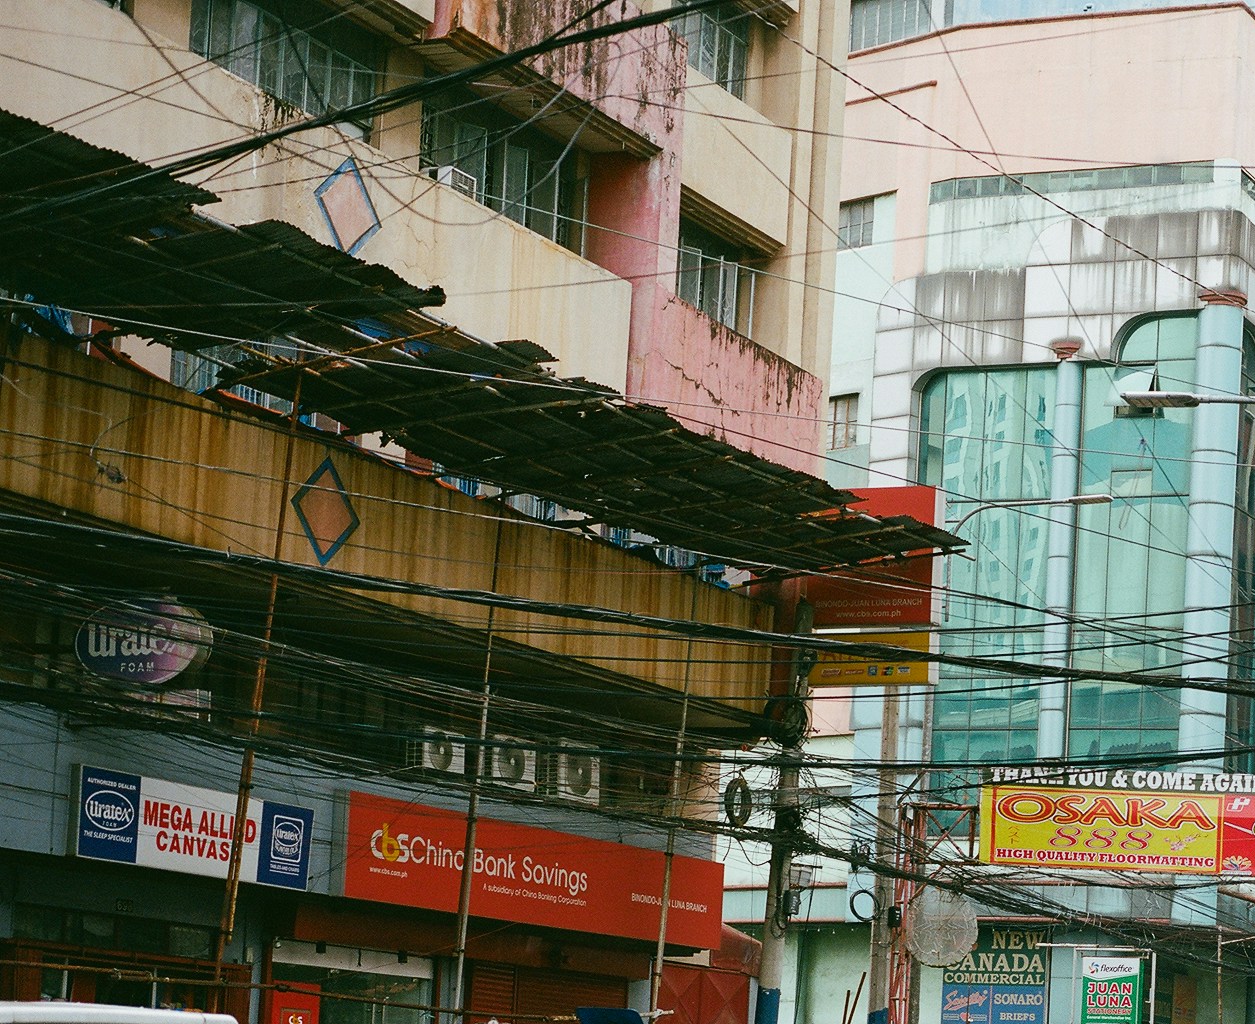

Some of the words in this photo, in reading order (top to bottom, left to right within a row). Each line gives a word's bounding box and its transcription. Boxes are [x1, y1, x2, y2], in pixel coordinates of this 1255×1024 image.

[120, 662, 155, 672] FOAM
[1066, 768, 1107, 787] YOU
[1111, 770, 1128, 789] &
[1132, 770, 1197, 790] COME
[997, 792, 1217, 831] OSAKA
[143, 799, 194, 833] MEGA
[197, 810, 258, 844] ALLID
[156, 830, 231, 862] CANVAS
[1049, 826, 1152, 850] 888
[996, 848, 1033, 860] HIGH
[1036, 850, 1097, 864] QUALITY
[1099, 852, 1215, 868] FLOORMATTING
[473, 848, 517, 880] Bank
[521, 856, 588, 897] Savings
[482, 883, 488, 891] A
[488, 884, 515, 897] subsidiary
[515, 888, 521, 896] of
[521, 889, 538, 899] China
[538, 891, 558, 904] Banking
[557, 895, 588, 907] Corporation
[671, 899, 686, 909] LUNA
[685, 901, 708, 913] BRANCH
[992, 930, 1047, 950] NEW
[1100, 962, 1133, 974] flexoffice
[944, 972, 1044, 986] COMMERCIAL
[1087, 981, 1133, 995] JUAN
[993, 993, 1044, 1006] SONARO
[1086, 994, 1133, 1007] LUNA
[999, 1013, 1036, 1021] BRIEFS
[1086, 1007, 1132, 1015] STATIONERY
